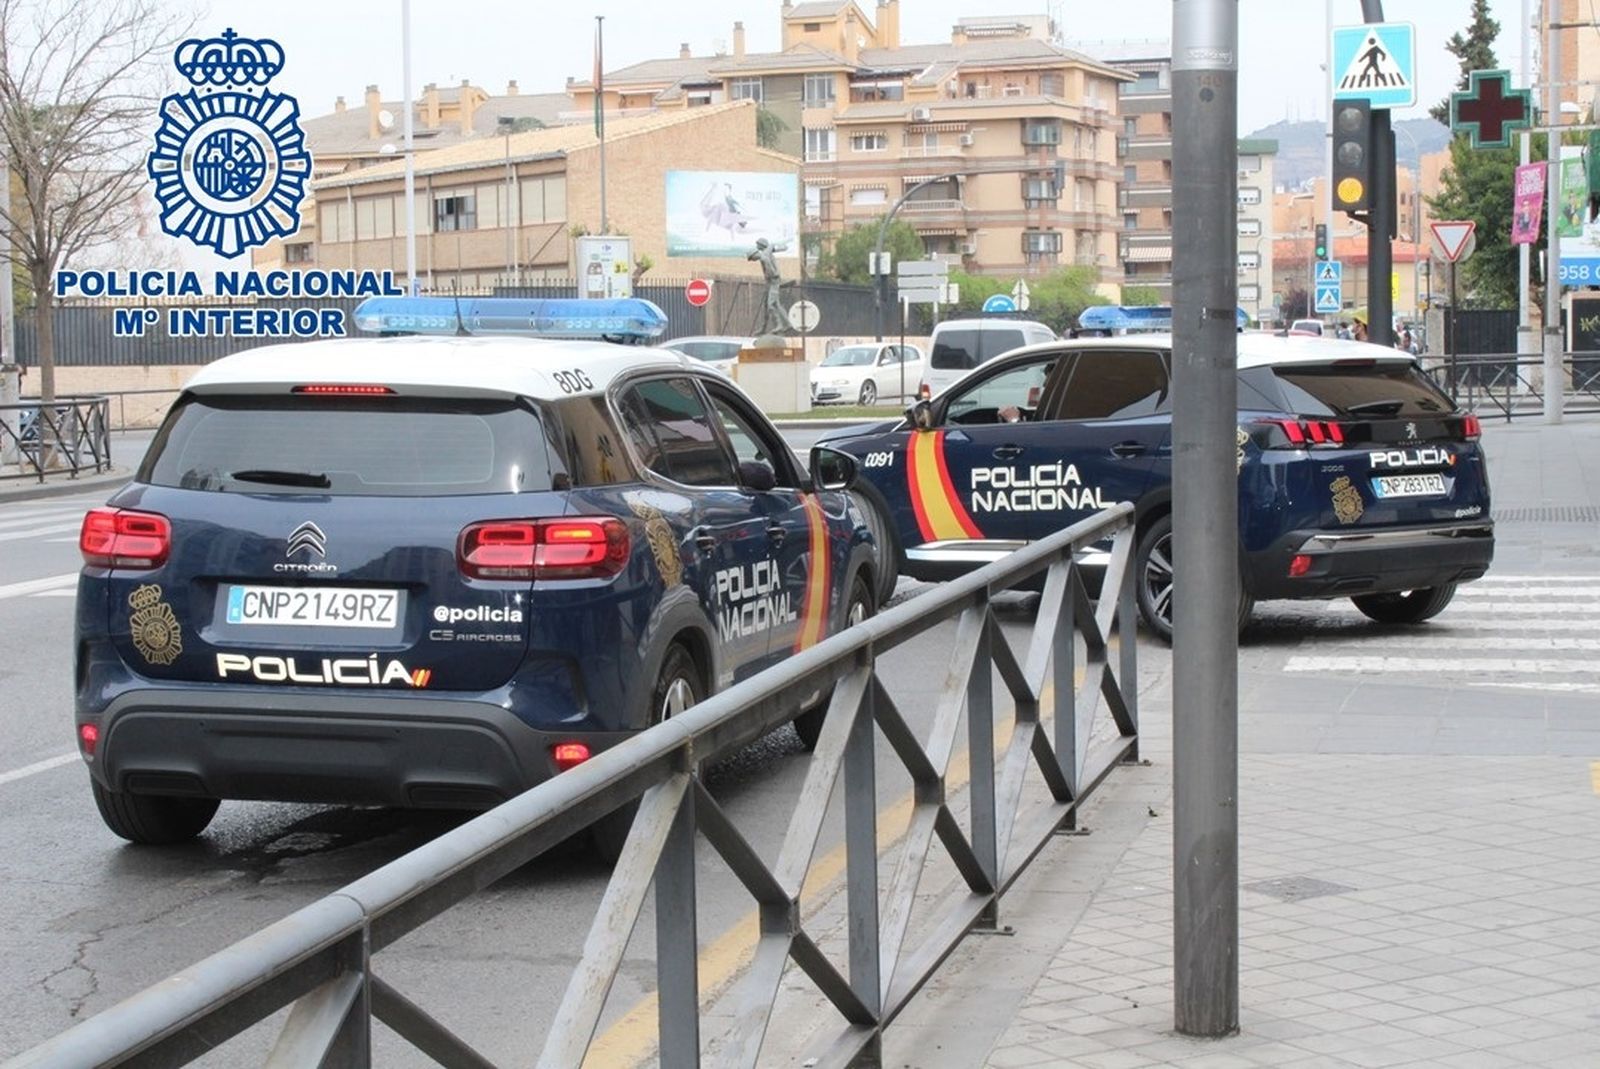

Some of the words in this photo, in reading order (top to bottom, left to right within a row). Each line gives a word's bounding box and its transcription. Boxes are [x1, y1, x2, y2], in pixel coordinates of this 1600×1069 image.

[552, 368, 593, 394] 8DG
[1369, 446, 1450, 468] POLICÍA
[971, 460, 1081, 489] POLICÍA
[1380, 475, 1444, 494] CNP2831RZ
[971, 487, 1117, 513] NACIONAL
[716, 553, 781, 606] POLICÍA
[242, 591, 395, 623] CNP2149RZ
[433, 605, 523, 624] @policia
[719, 591, 797, 645] NACIONAL
[456, 634, 522, 642] AIRCROSS
[216, 653, 414, 684] POLICÍA
